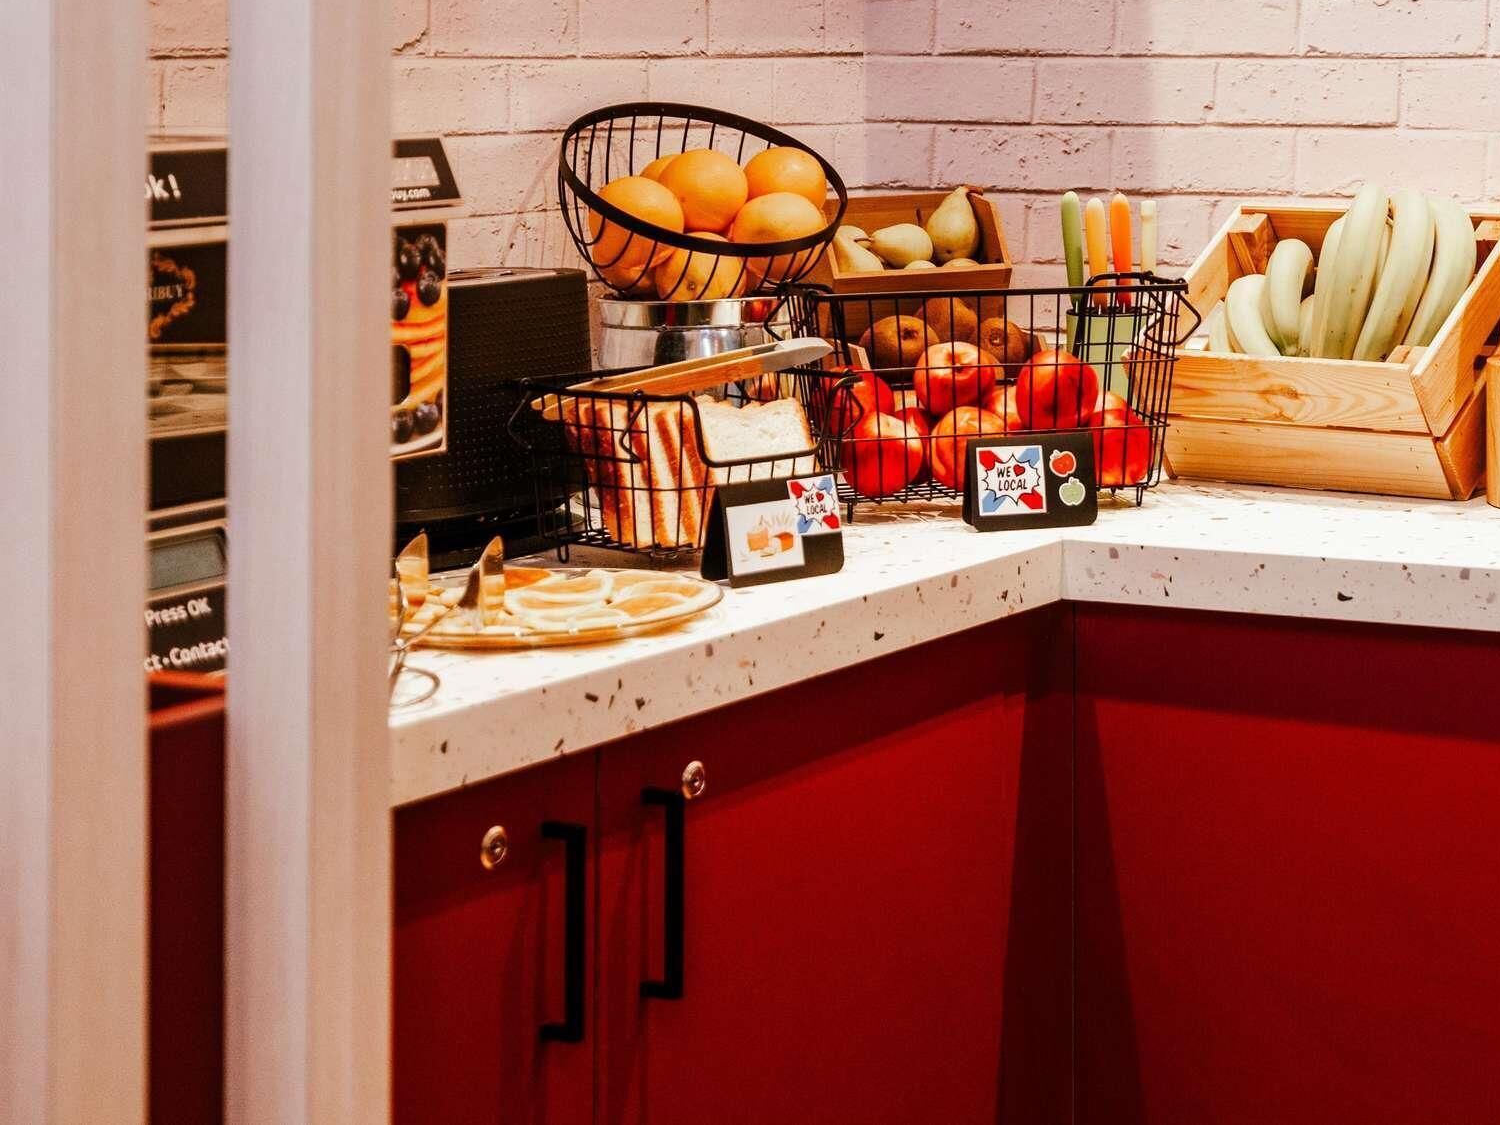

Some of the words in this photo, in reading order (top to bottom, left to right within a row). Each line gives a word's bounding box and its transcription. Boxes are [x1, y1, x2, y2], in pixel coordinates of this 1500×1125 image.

[997, 466, 1011, 478] WE
[998, 478, 1028, 491] LOCAL
[804, 493, 815, 504] WE
[806, 503, 828, 515] LOCAL
[187, 597, 212, 616] OK
